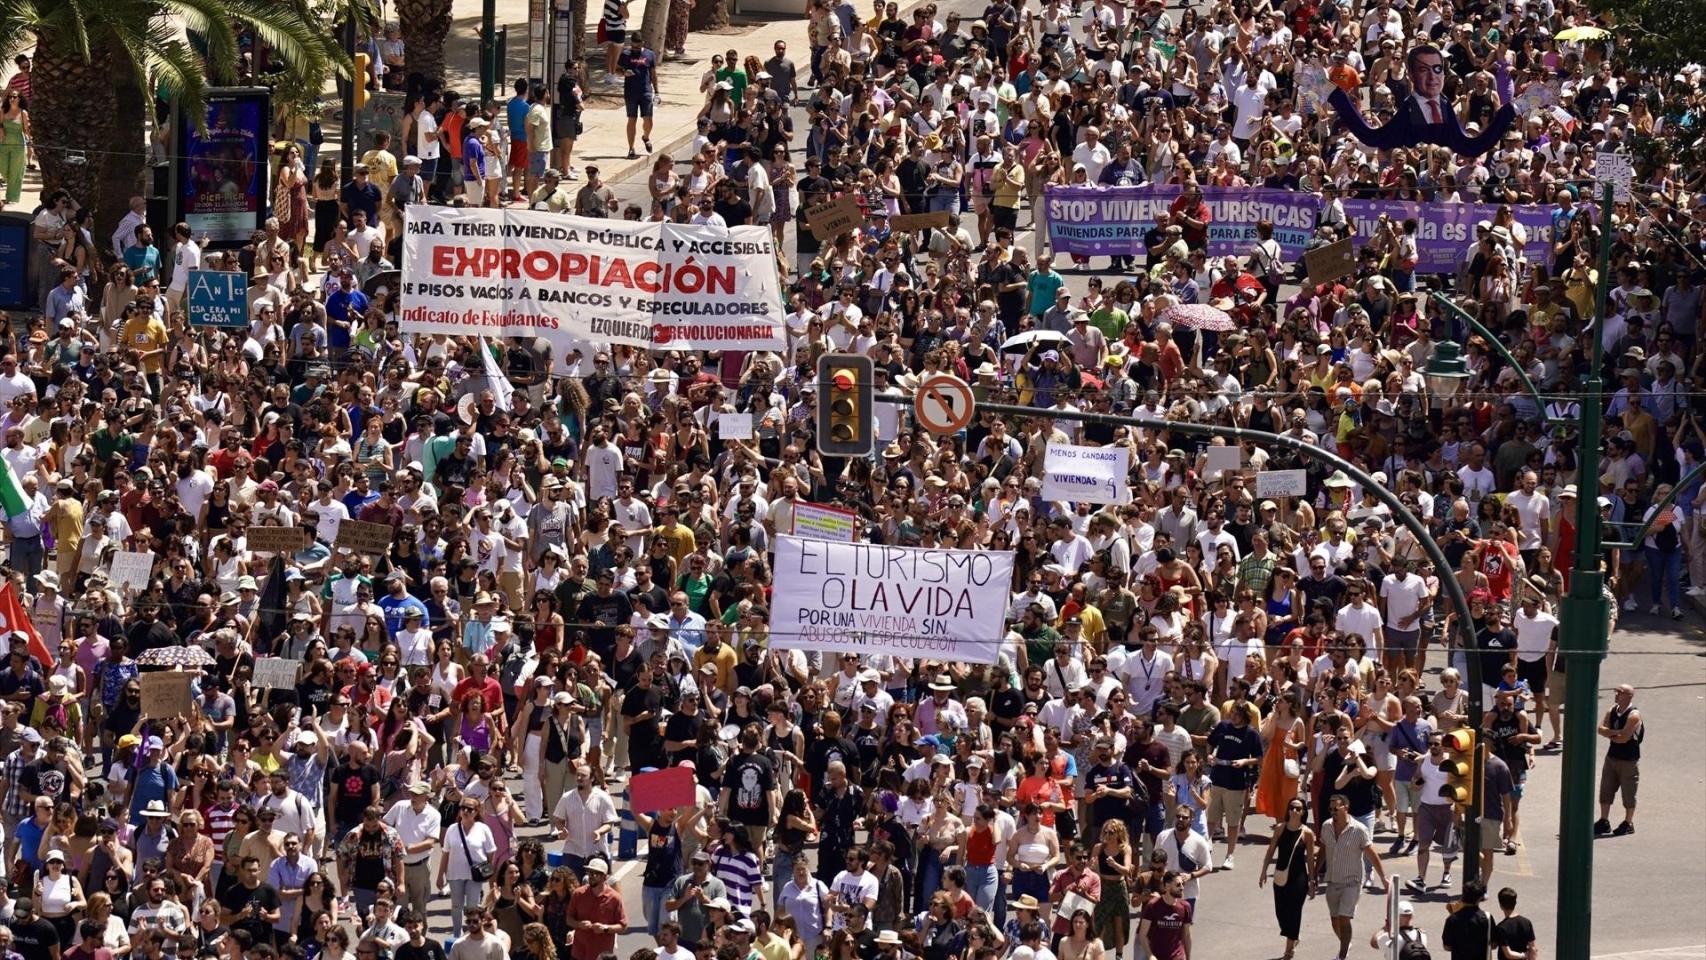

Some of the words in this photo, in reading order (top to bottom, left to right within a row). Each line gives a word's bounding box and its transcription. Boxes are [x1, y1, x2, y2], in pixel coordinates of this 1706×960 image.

[1050, 199, 1097, 222] STOP
[408, 221, 444, 235] PARA
[452, 223, 496, 236] TENER
[500, 224, 580, 242] VIVIENDA
[587, 229, 665, 252] PÚBLICA
[672, 240, 684, 253] Y
[688, 241, 771, 256] ACCESIBLE
[1056, 226, 1113, 238] VIVIENDAS
[1116, 226, 1146, 238] PARA
[1210, 228, 1240, 239] PARA
[1442, 224, 1466, 242] es
[432, 245, 736, 295] EXPROPIACIÓN
[190, 305, 206, 313] ESA
[210, 306, 226, 314] ERA
[418, 283, 464, 298] PISOS
[470, 283, 514, 300] VACÍOS
[518, 288, 532, 300] A
[538, 289, 612, 307] BANCOS
[618, 296, 632, 308] Y
[636, 299, 770, 315] ESPECULADORES
[202, 313, 230, 322] CASA
[462, 309, 480, 325] de
[482, 310, 560, 330] Estudiantes
[590, 318, 654, 342] IZQUIERDA
[670, 325, 774, 340] REVOLUCIONARIA
[1050, 448, 1077, 458] MENOS
[1082, 452, 1117, 461] CANDADOS
[1054, 474, 1097, 486] VIVIENDAS
[800, 540, 845, 576] EL
[843, 541, 992, 586] TURISMO
[822, 578, 844, 608] O
[850, 578, 888, 612] LA
[896, 583, 974, 620] VIDA
[798, 608, 830, 624] POR
[833, 612, 856, 628] UNA
[860, 614, 916, 632] VIVIENDA
[798, 626, 850, 644] ABUSOS
[852, 632, 866, 645] NI
